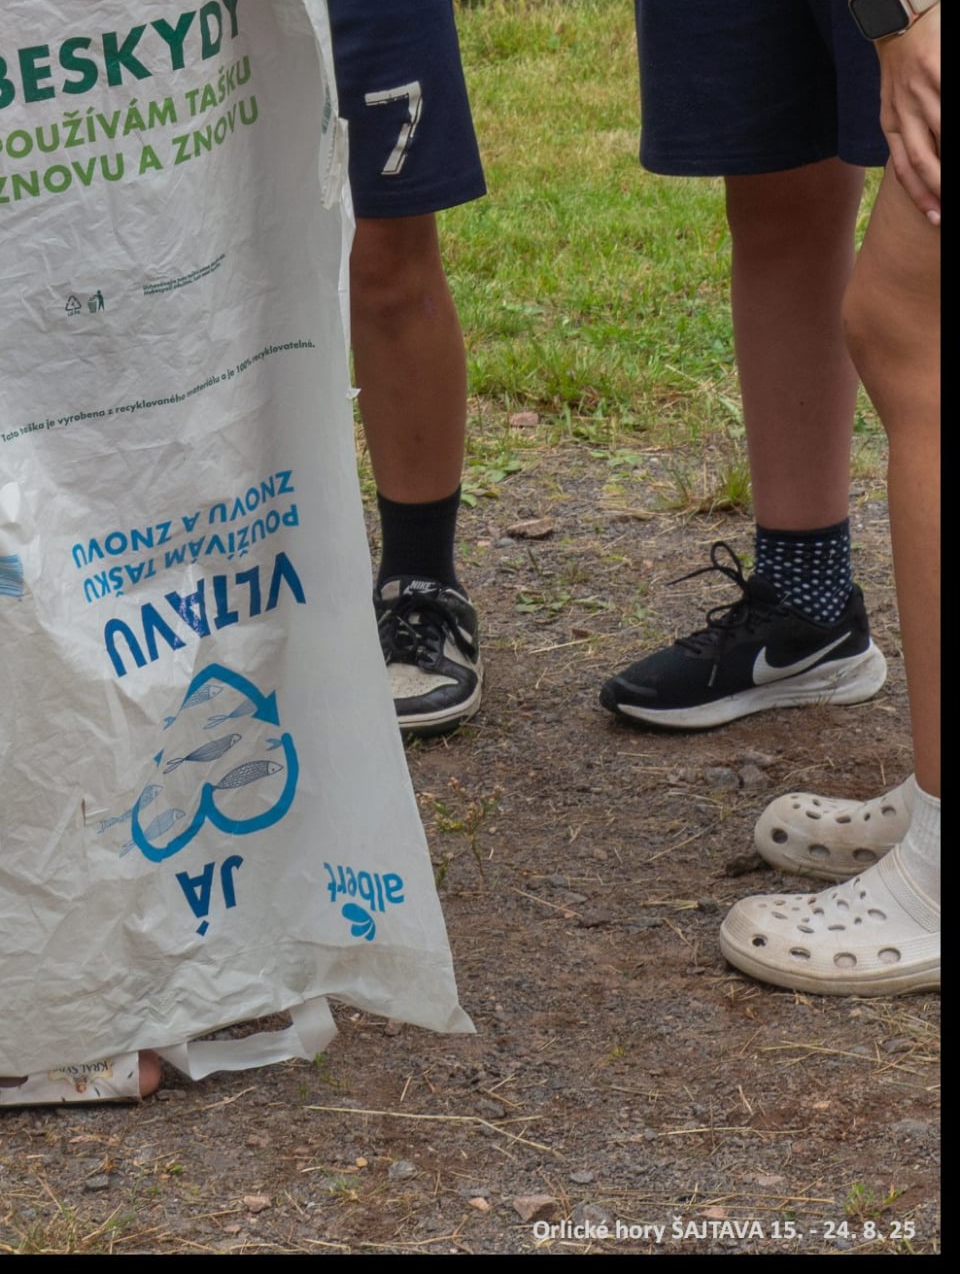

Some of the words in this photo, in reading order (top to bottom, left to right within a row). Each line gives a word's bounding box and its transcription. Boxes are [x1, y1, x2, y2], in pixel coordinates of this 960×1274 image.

[185, 55, 252, 117] TAŠKU
[138, 144, 163, 175] A
[171, 95, 259, 166] ZNOVU
[364, 80, 423, 175] 7
[46, 418, 55, 430] je
[57, 407, 106, 427] vyrobena
[115, 393, 186, 415] recyklovaného
[182, 511, 200, 533] A
[209, 470, 295, 525] ZNOVU
[72, 520, 172, 569] ZNOVU
[164, 504, 300, 570] POUŽÍVÁM
[83, 558, 157, 604] TAŠKU
[104, 551, 307, 678] VLTAVU
[175, 855, 244, 937] JÁ
[323, 862, 405, 913] albert
